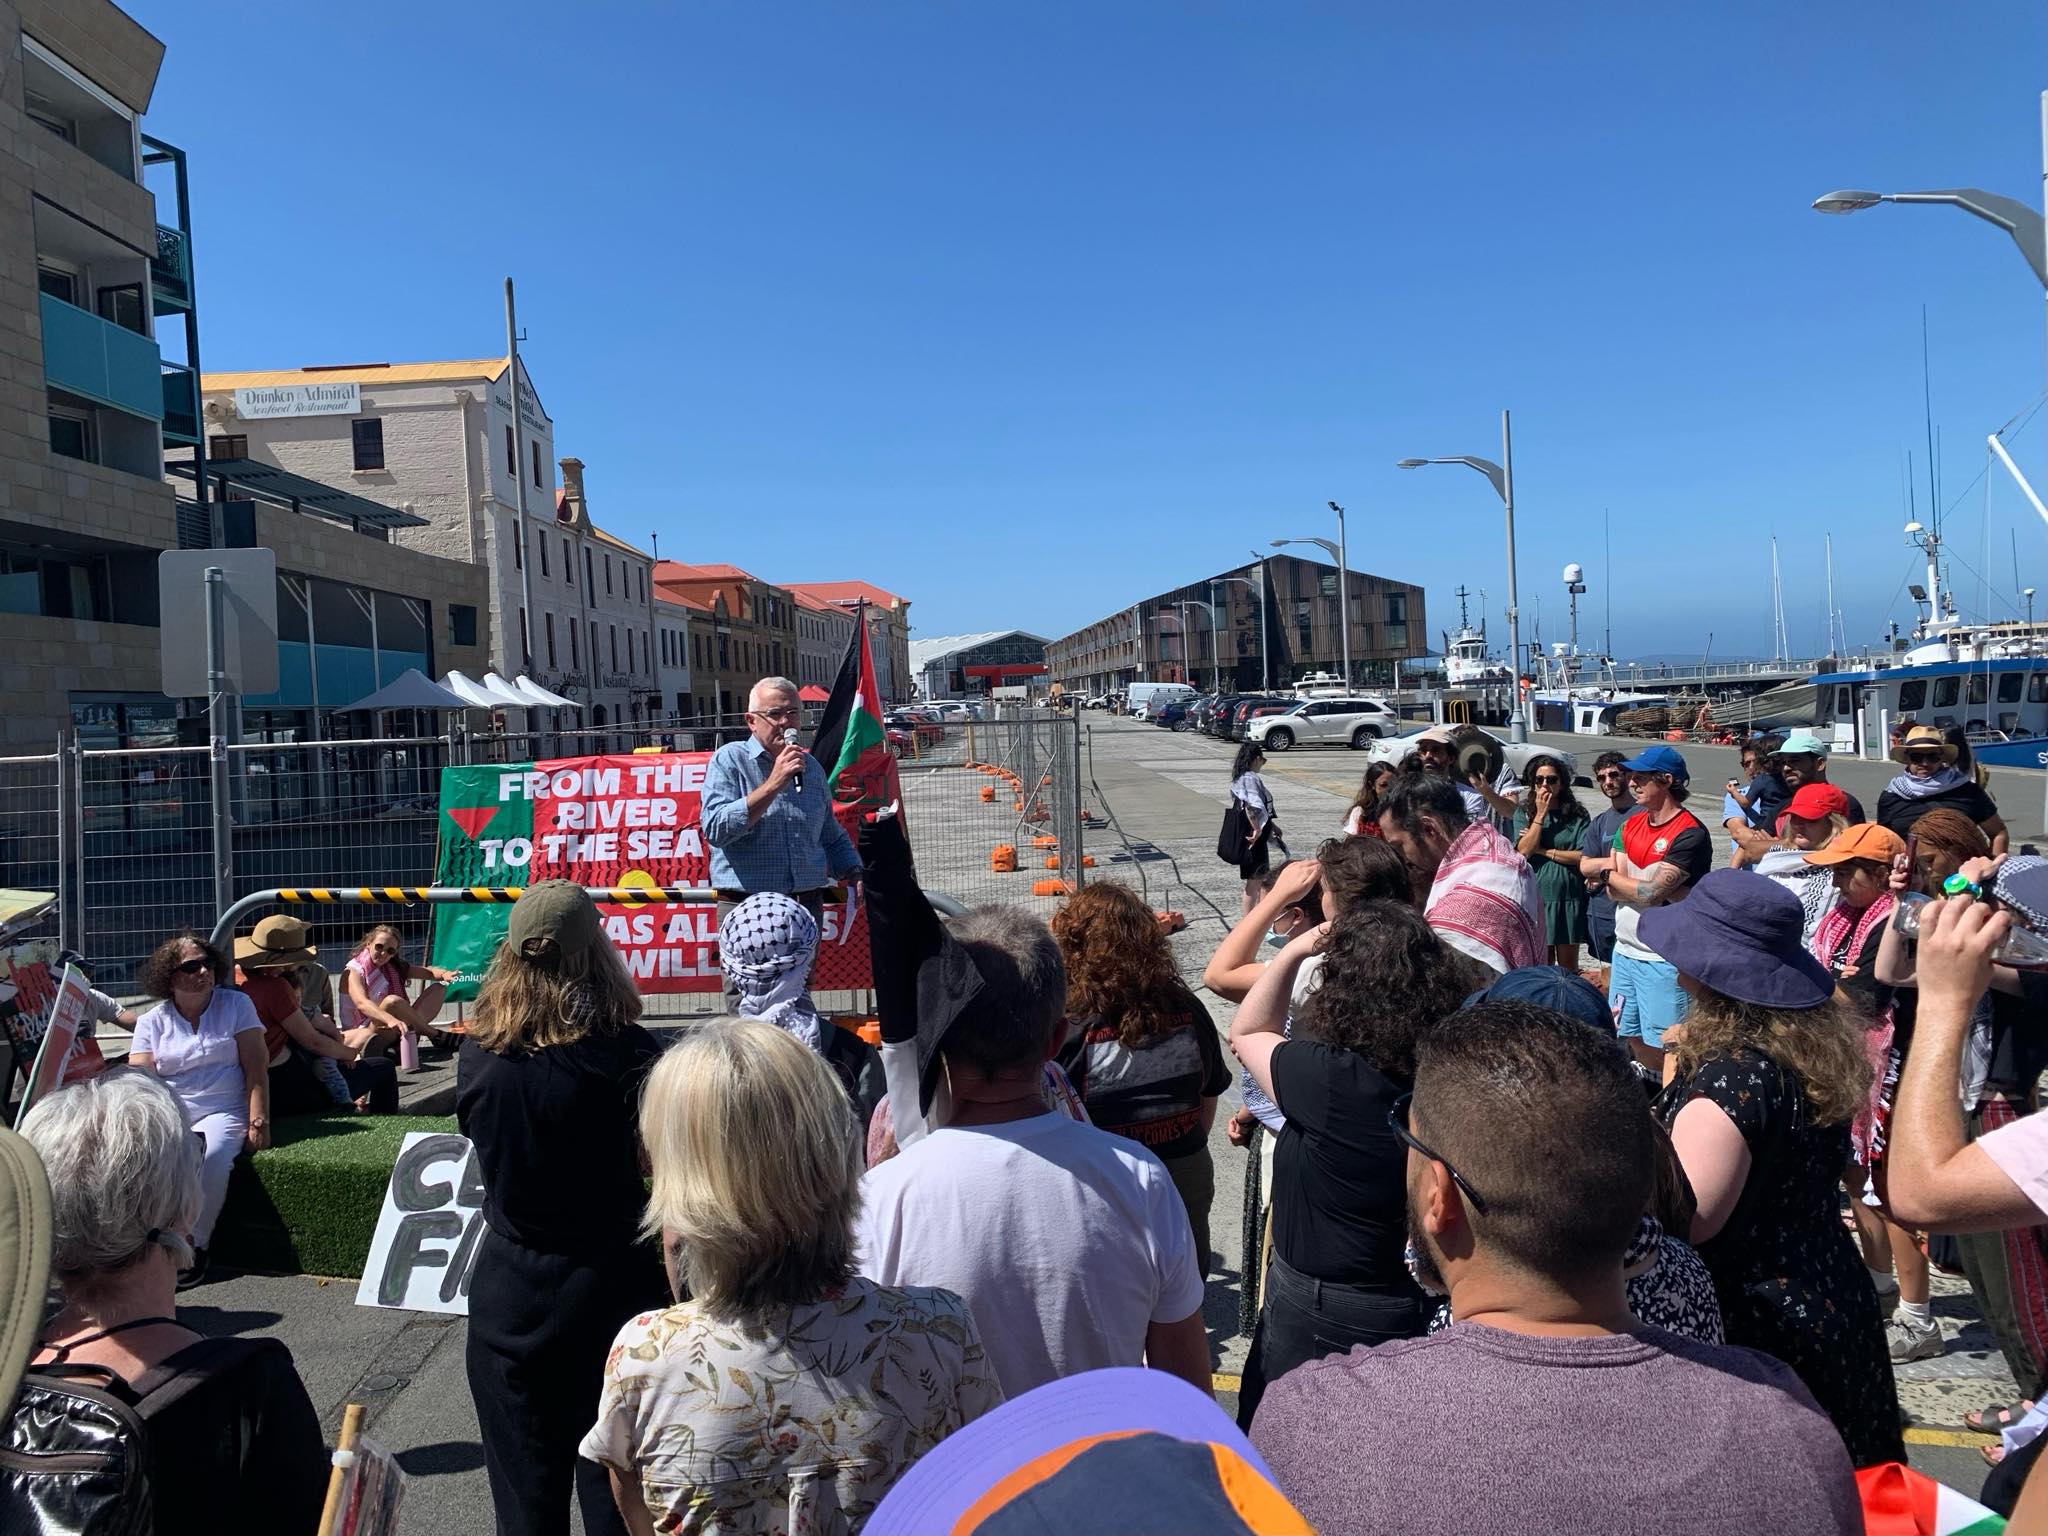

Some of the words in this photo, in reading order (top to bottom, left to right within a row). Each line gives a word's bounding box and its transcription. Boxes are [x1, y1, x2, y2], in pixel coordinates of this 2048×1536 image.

[246, 389, 295, 405] Drunken
[304, 384, 355, 402] Admiral
[250, 403, 291, 416] Seafood
[294, 400, 349, 413] Restaurant
[499, 767, 621, 801] FROM
[631, 764, 707, 793] THE
[557, 797, 677, 830] RIVER
[479, 837, 533, 868] TO
[543, 831, 619, 863] THE
[627, 829, 704, 860] SEA
[626, 947, 723, 978] WILL
